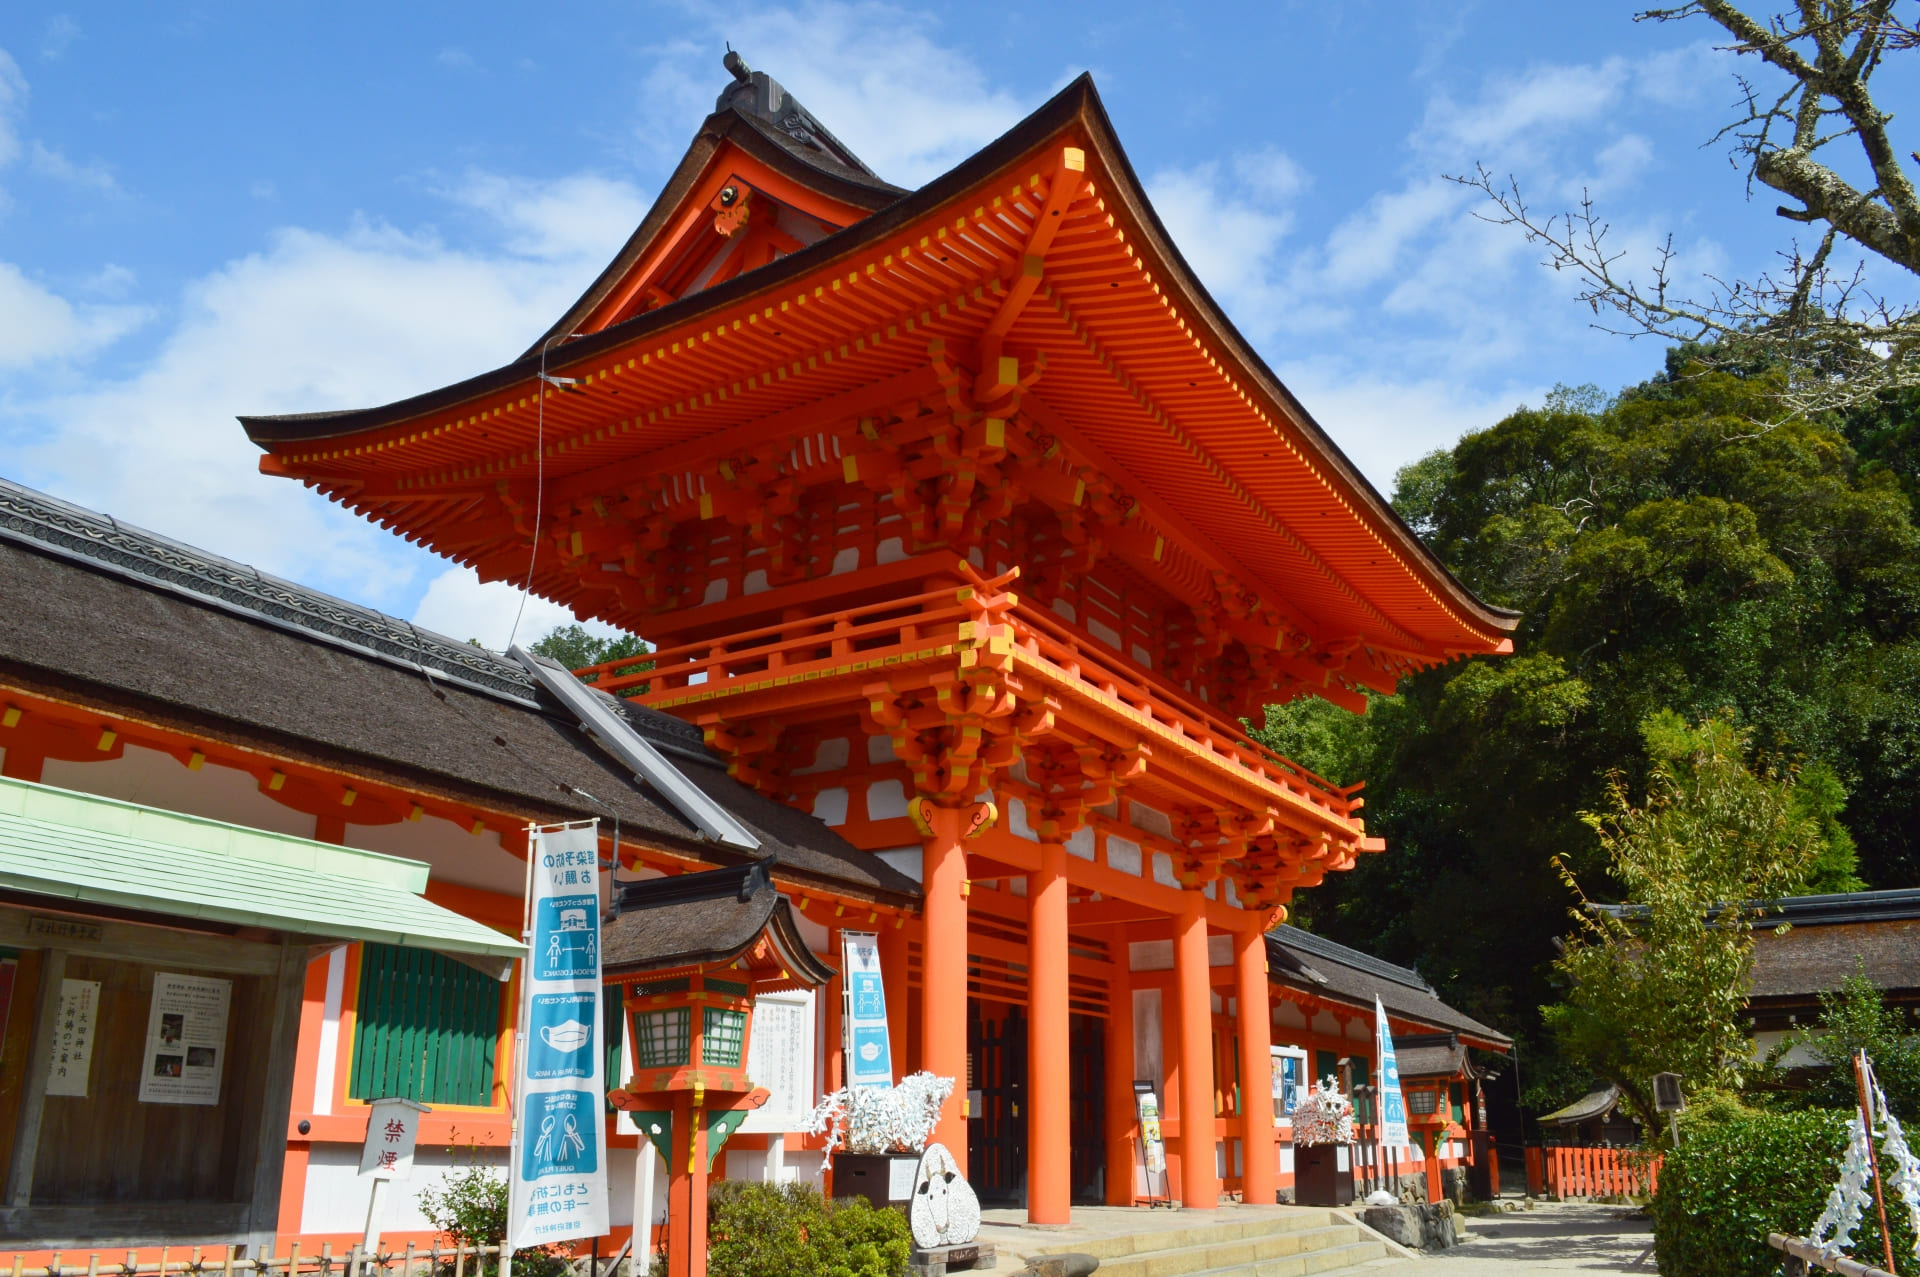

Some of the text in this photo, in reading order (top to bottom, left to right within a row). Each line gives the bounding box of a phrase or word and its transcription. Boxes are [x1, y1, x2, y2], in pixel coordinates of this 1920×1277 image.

[73, 1012, 87, 1061] 大田神社
[376, 1118, 405, 1171] 禁煙
